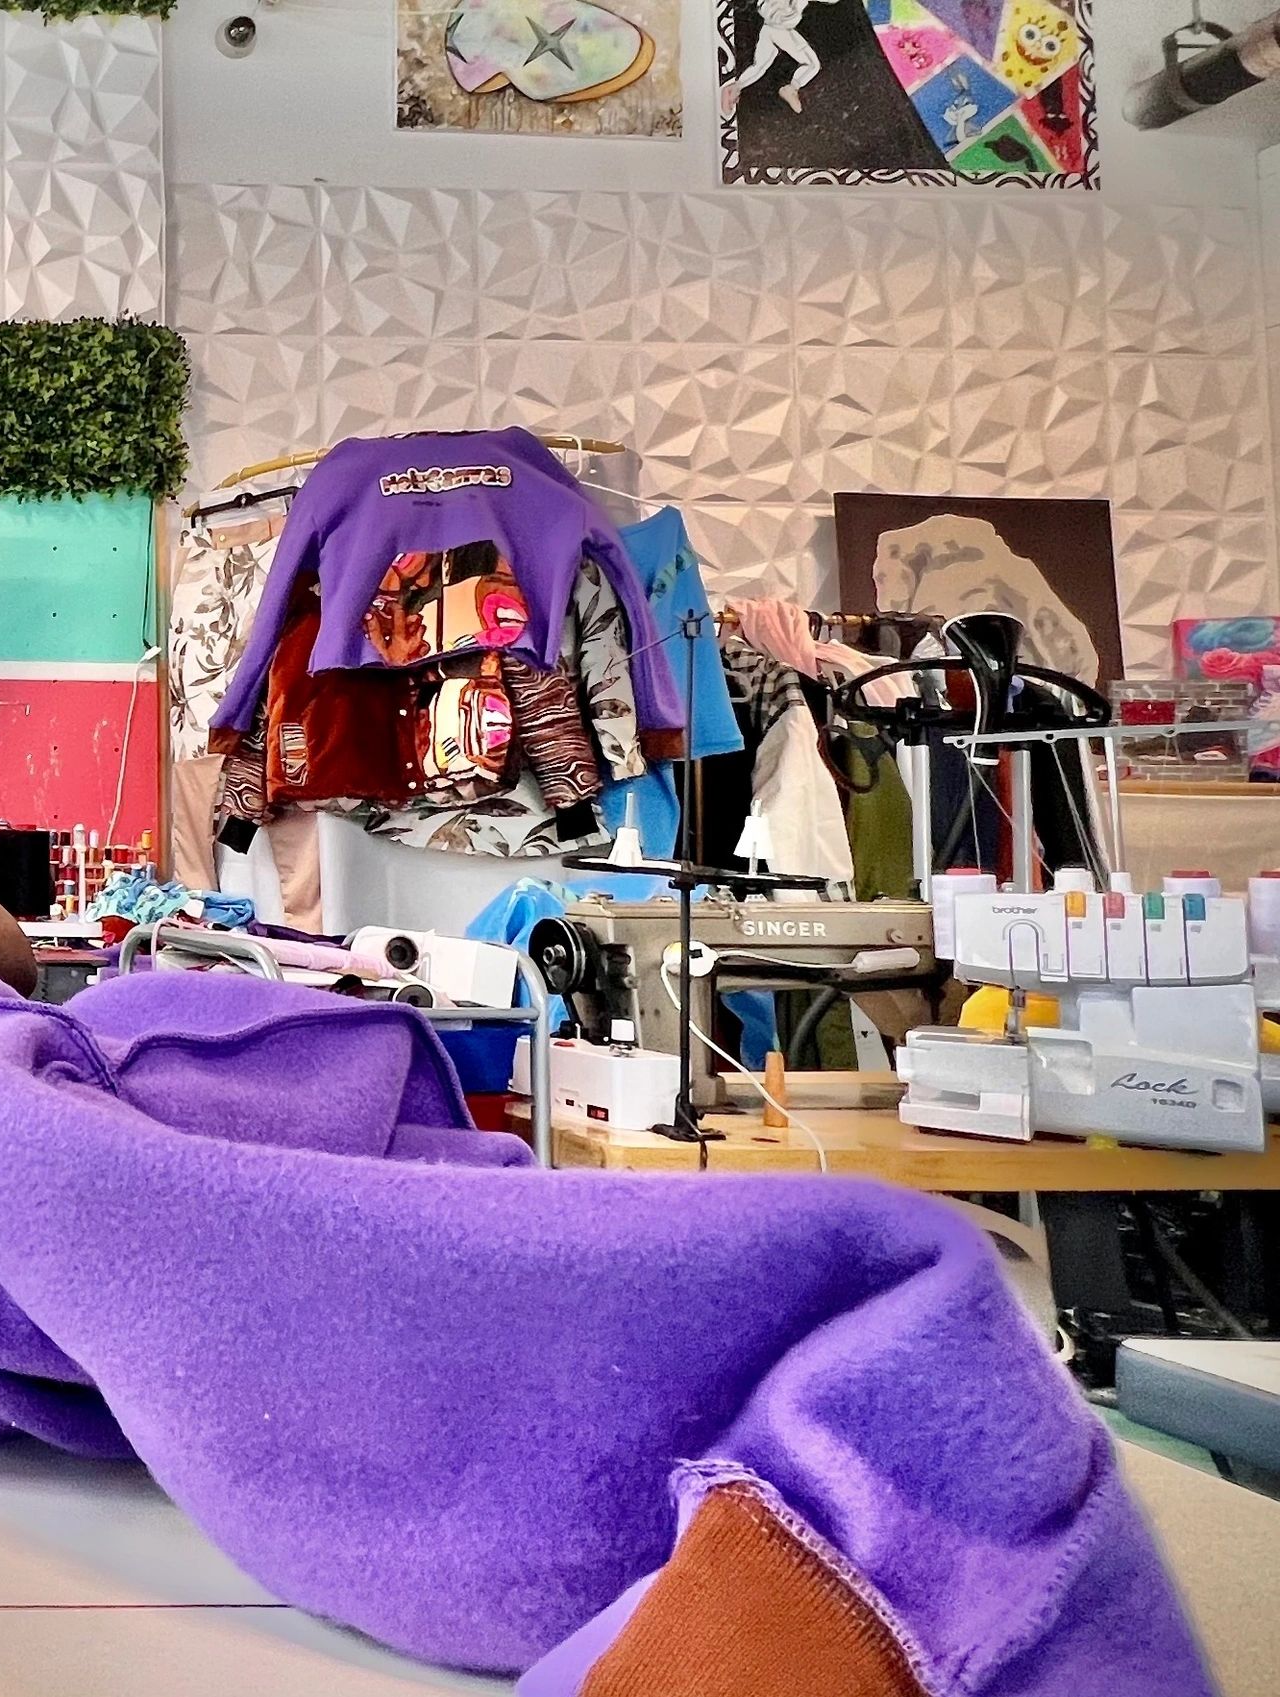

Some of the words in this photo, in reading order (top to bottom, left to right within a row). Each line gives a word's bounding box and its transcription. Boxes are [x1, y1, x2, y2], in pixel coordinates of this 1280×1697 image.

[991, 905, 1038, 914] brother
[743, 920, 826, 937] SINGER
[1111, 1072, 1199, 1095] Lock
